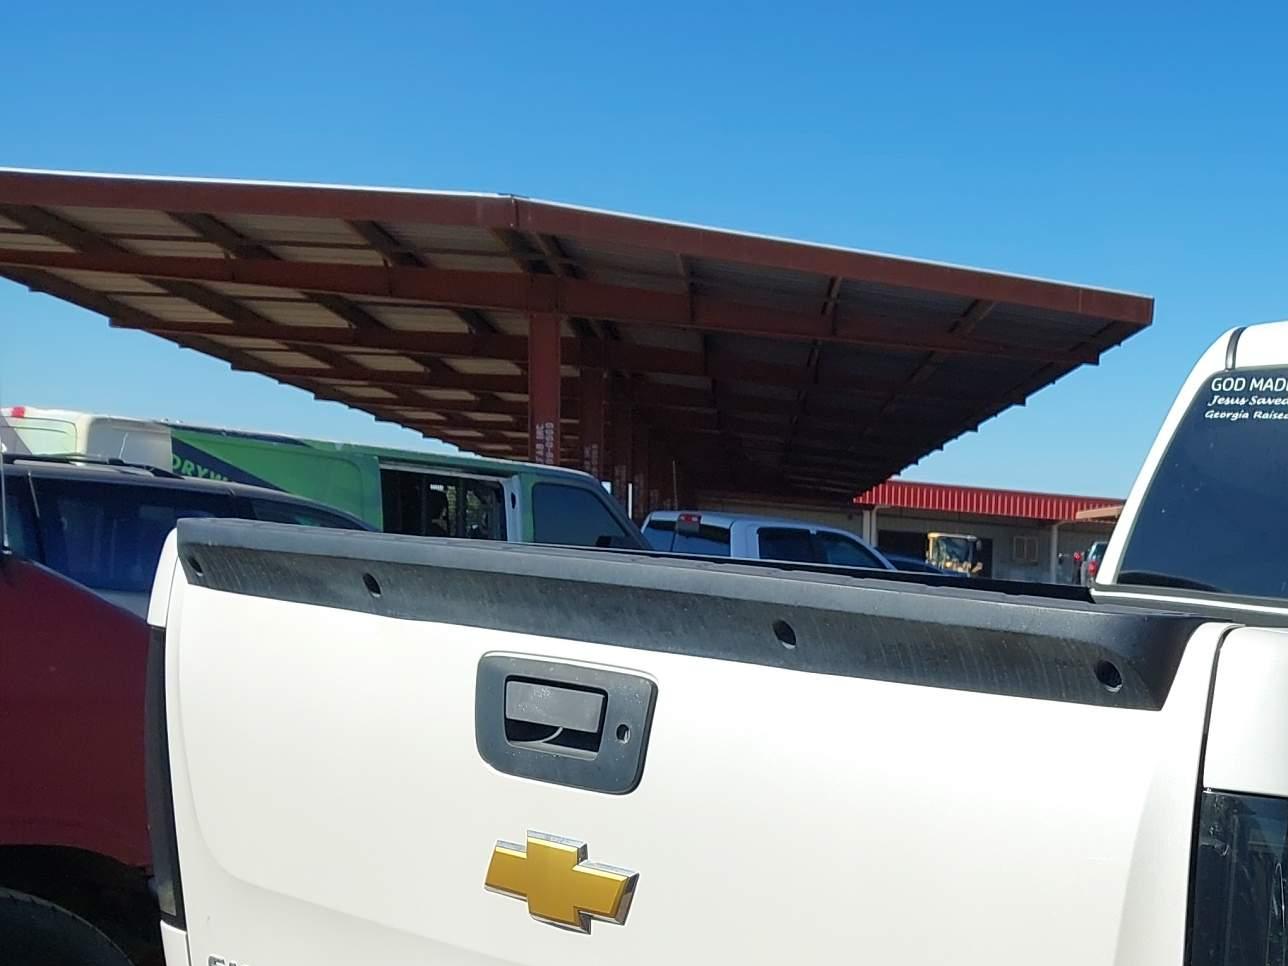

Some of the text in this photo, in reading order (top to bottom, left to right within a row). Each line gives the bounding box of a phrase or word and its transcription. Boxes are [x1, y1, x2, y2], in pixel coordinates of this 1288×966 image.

[1211, 377, 1246, 392] GOD
[1207, 394, 1248, 407] Jesus
[1204, 409, 1249, 421] Georgia
